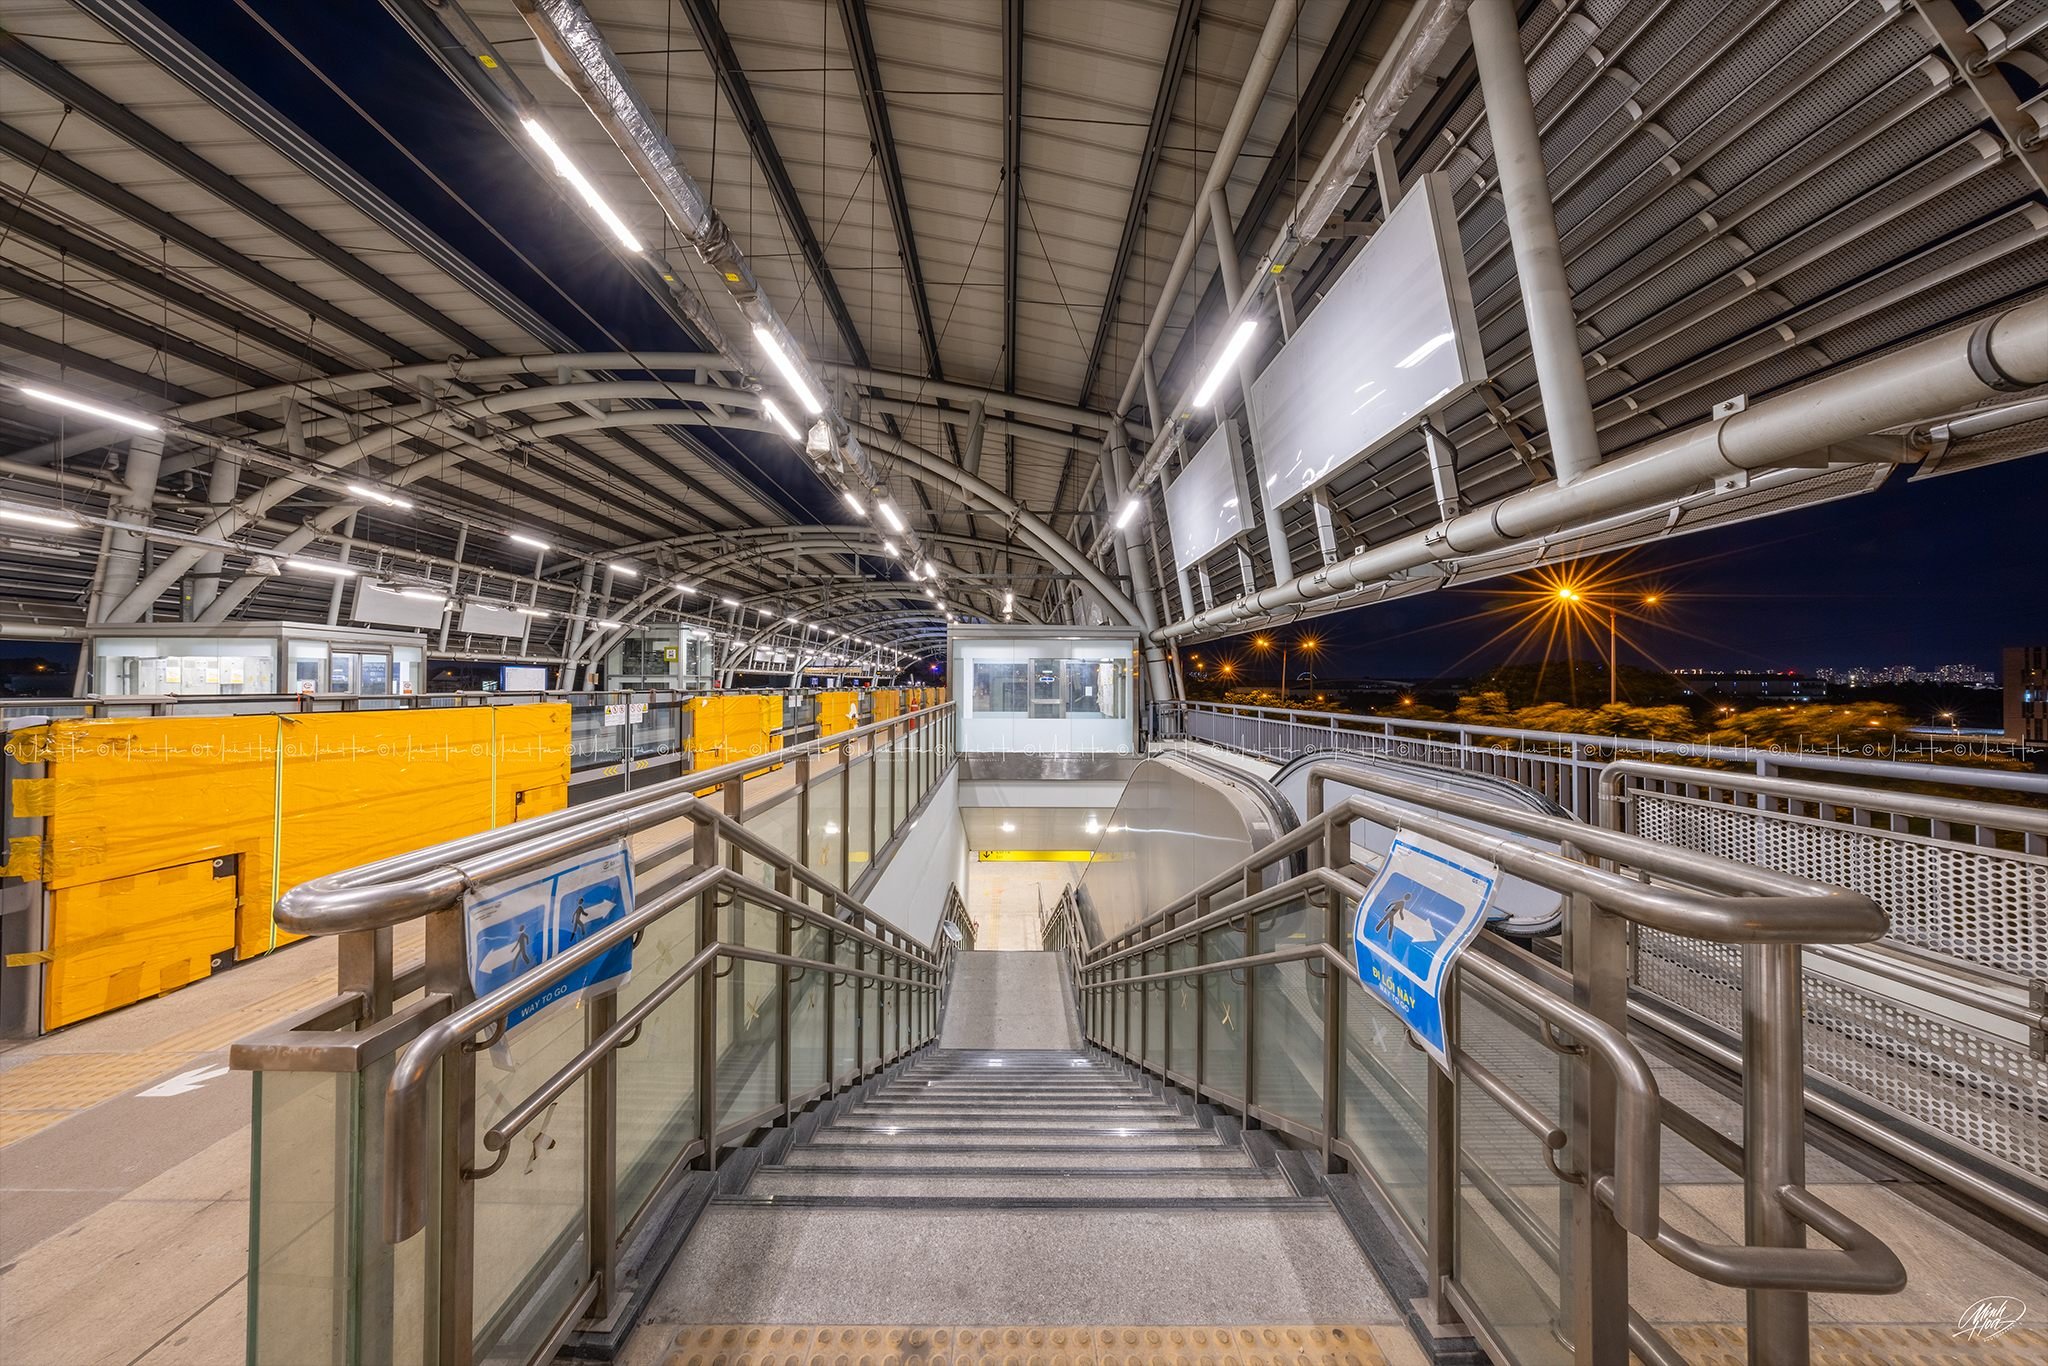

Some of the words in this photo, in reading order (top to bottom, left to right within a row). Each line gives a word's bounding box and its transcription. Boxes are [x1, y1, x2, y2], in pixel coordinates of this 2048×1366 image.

[521, 999, 540, 1017] WAY
[542, 993, 553, 1004] TO
[554, 984, 567, 997] GO
[1400, 1001, 1410, 1012] GO
